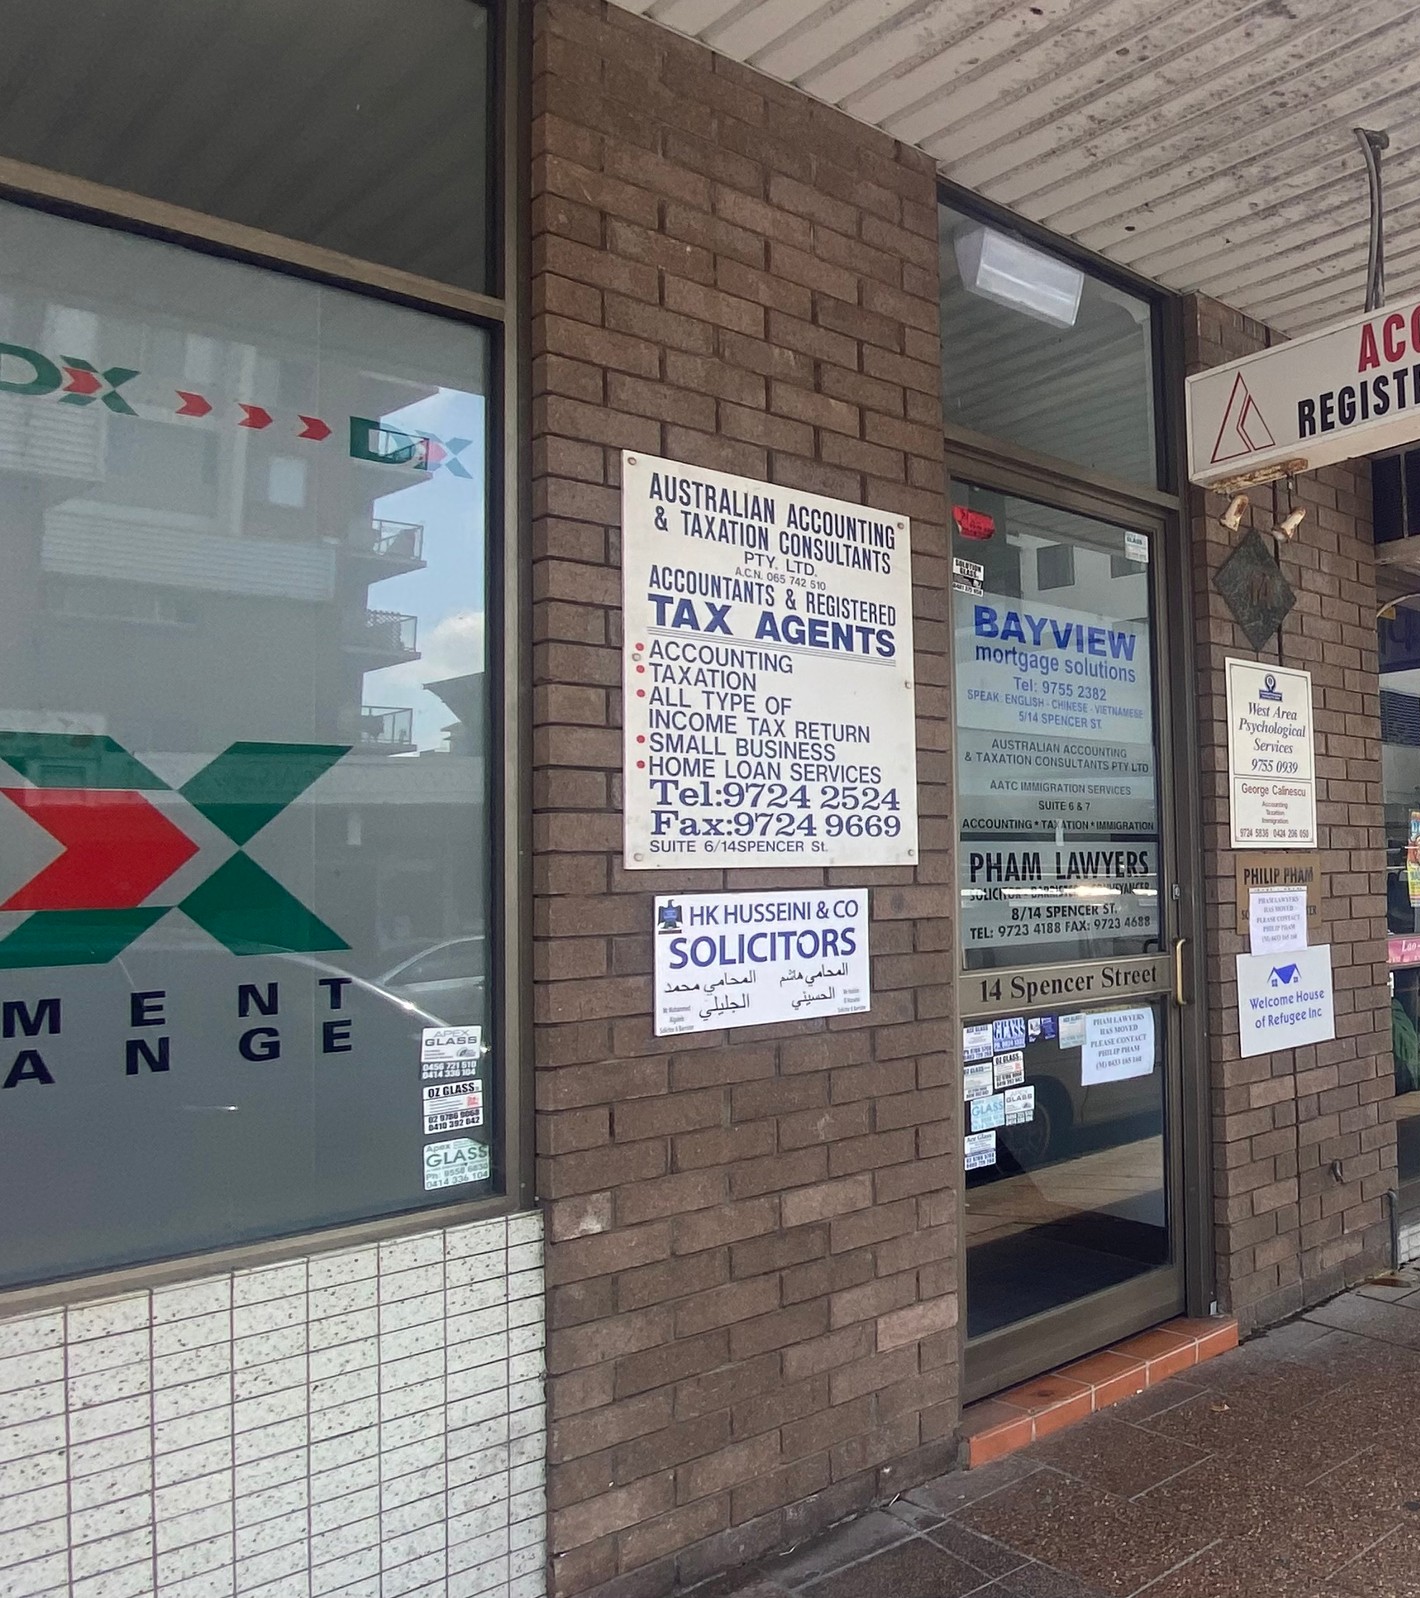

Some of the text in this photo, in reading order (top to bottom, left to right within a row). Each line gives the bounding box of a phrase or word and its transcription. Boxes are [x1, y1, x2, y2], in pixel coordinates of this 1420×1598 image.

[649, 472, 775, 525] AUSTRALIAN
[787, 504, 895, 550] ACCOUNTING
[654, 506, 891, 575] & TAXATION CONSULTANTS
[744, 551, 818, 577] PTY. LTD.
[735, 566, 826, 590] A.C.N. 065 742 510
[649, 565, 896, 627] ACCOUNTANTS & REGISTERED
[648, 593, 896, 657] TAX AGENTS
[974, 605, 1136, 661] BAYVIEW
[649, 640, 793, 674] ACCOUNTING
[976, 644, 1135, 683] mortgage solutions
[650, 663, 756, 692] TAXATION
[1014, 677, 1107, 701] Tel: 9755 2382
[649, 686, 792, 716] ALL TYPE OF
[1005, 694, 1044, 707] ENGLISH
[1051, 700, 1087, 713] CHINESE
[1094, 704, 1144, 719] VIETNAMESE
[1248, 702, 1297, 720] West Area
[649, 709, 870, 743] INCOME TAX RETURN
[1019, 711, 1038, 722] 5/14
[1042, 713, 1087, 727] SPENCER
[1239, 718, 1306, 738] Psychological
[649, 733, 836, 762] SMALL BUSINESS
[992, 739, 1127, 758] AUSTRALIAN ACCOUNTING
[1254, 738, 1293, 754] Services
[649, 756, 881, 784] HOME LOAN SERVICES
[976, 753, 1031, 766] TAXATION
[1035, 757, 1109, 771] CONSULTANTS
[1112, 762, 1129, 772] PTY
[1132, 762, 1149, 773] LTD
[1251, 759, 1298, 773] 9755 0939
[820, 785, 900, 811] 2524
[990, 780, 1131, 795] AATC IMMIGRATION SERVICES
[1242, 783, 1269, 797] George
[1038, 801, 1090, 811] SUITE 6 & 7
[1262, 800, 1288, 809] Accounting
[825, 814, 901, 838] 9669
[962, 819, 1033, 829] ACCOUNTING
[1096, 821, 1154, 830] IMMIGRATION
[650, 840, 696, 852] SUITE
[970, 851, 1149, 883] PHAM LAWYERS
[1244, 867, 1313, 885] PHILIP PHAM
[690, 900, 858, 926] HK HUSSEINI & CO
[1012, 903, 1118, 922] 8/14 SPENCER ST.
[970, 916, 1150, 939] TEL: 9723 4188 FAX: 9723 4688
[669, 927, 856, 970] SOLICITORS
[704, 970, 756, 994] المحامي
[805, 963, 849, 986] المحامي
[980, 965, 1157, 1003] 14 Spencer Street
[699, 994, 750, 1021] الجليلي
[791, 987, 835, 1010] الحسيني
[1250, 989, 1324, 1010] Welcome House
[1093, 1017, 1112, 1025] PHAM
[1115, 1024, 1138, 1032] MOVED
[1255, 1007, 1322, 1028] of Refugee Inc
[425, 1036, 477, 1046] GLASS
[434, 1029, 469, 1037] APEX
[1091, 1034, 1147, 1048] PLEASE CONTACT
[1121, 1045, 1140, 1053] PHAM
[428, 1082, 475, 1097] OZ GLASS
[426, 1144, 450, 1153] Apex
[427, 1145, 488, 1167] GLASS
[426, 1179, 449, 1188] 0414
[452, 1175, 469, 1183] 336
[473, 1171, 488, 1179] 104
